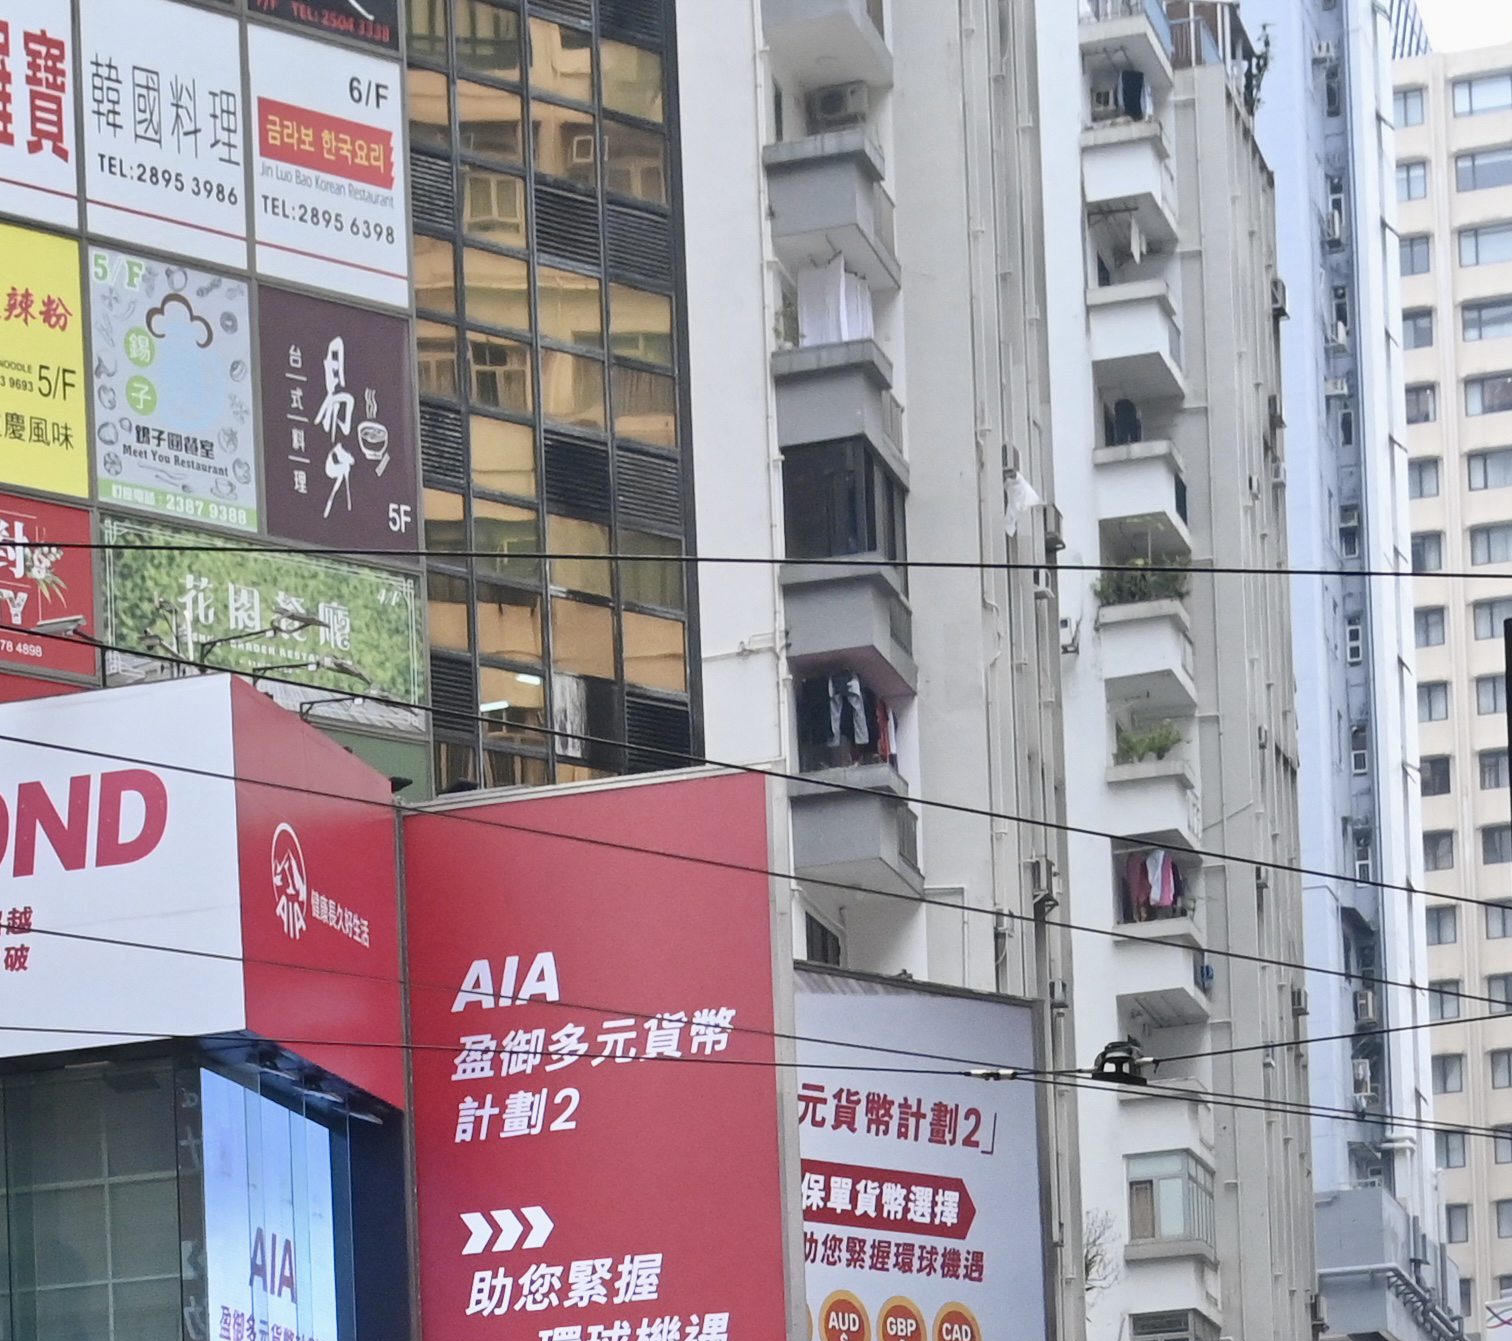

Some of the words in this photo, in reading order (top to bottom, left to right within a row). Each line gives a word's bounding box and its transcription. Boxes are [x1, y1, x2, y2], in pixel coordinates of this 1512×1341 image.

[89, 53, 240, 167] 韓國料理
[349, 77, 389, 109] 6/F
[266, 115, 314, 153] 금라보
[321, 129, 385, 173] 한국요리
[98, 153, 185, 193] TEL:2895
[191, 174, 238, 206] 3986
[315, 174, 346, 197] Korean
[348, 182, 394, 210] Restaurant
[261, 195, 344, 232] TEL:2895
[350, 219, 395, 246] 6398
[92, 252, 145, 290] 5/F
[38, 365, 77, 401] 5/F
[288, 344, 309, 495] 台式料理
[122, 443, 149, 460] Meet
[152, 449, 172, 465] You
[173, 455, 229, 478] Restaurant
[165, 492, 204, 516] 2387
[208, 503, 247, 525] 9388
[388, 503, 412, 533] 5F
[276, 894, 307, 941] AIA
[310, 889, 370, 949] 健康長久好生活
[450, 951, 562, 1013] AIA
[451, 1007, 737, 1082] 盈御多元貨幣
[454, 1087, 581, 1144] 計劃2
[801, 1171, 960, 1229] 保單貨幣選擇
[249, 1227, 297, 1305] AIA
[464, 1253, 663, 1317] 助您緊握
[827, 1313, 861, 1335] AUD
[886, 1316, 918, 1340] GBP
